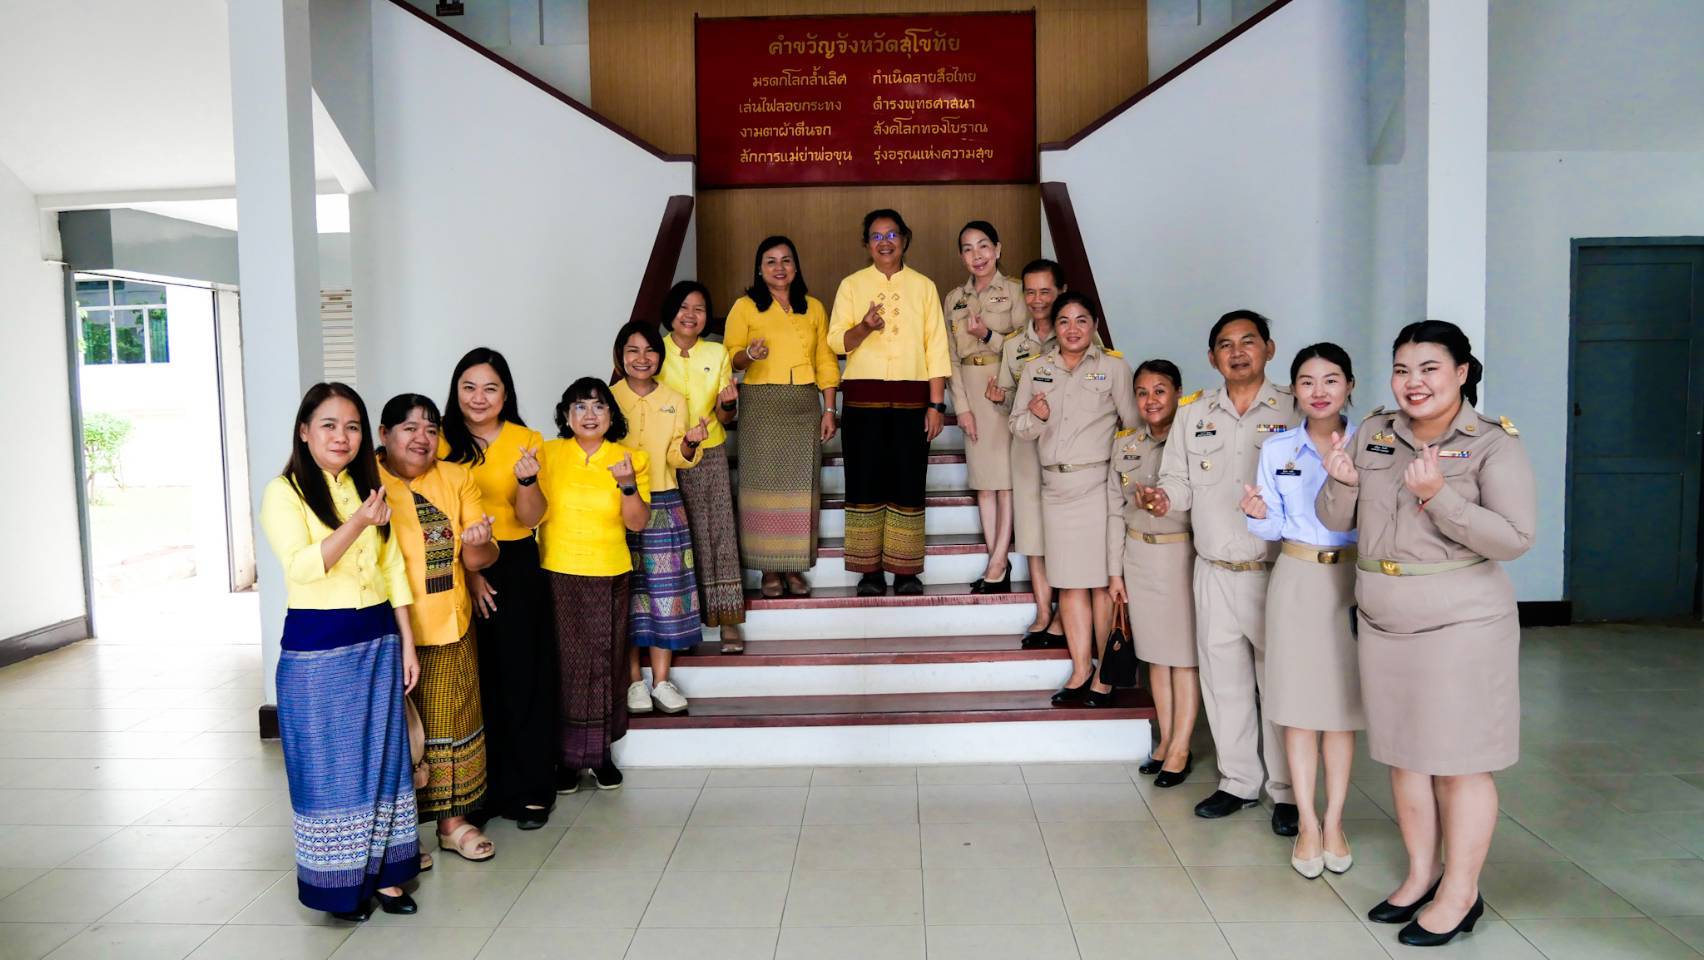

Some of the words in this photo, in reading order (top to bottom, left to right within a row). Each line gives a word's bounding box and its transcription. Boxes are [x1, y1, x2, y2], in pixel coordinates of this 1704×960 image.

[769, 29, 959, 58] คำขวัญจังหวัดสุโขทัย
[753, 66, 846, 87] มรดกโลกล้ำเลิศ
[873, 67, 976, 85] กำเนิดลายสือไทย
[740, 97, 841, 112] เล่นไฟลอยกระทง
[873, 96, 975, 114] ดำรงพุทธศาสนา
[740, 121, 831, 137] งามตาผ้าตีนจก
[873, 116, 988, 135] สังคโลกทองโบราณ
[874, 145, 993, 165] รุ่งอรุณแห่งความสุข
